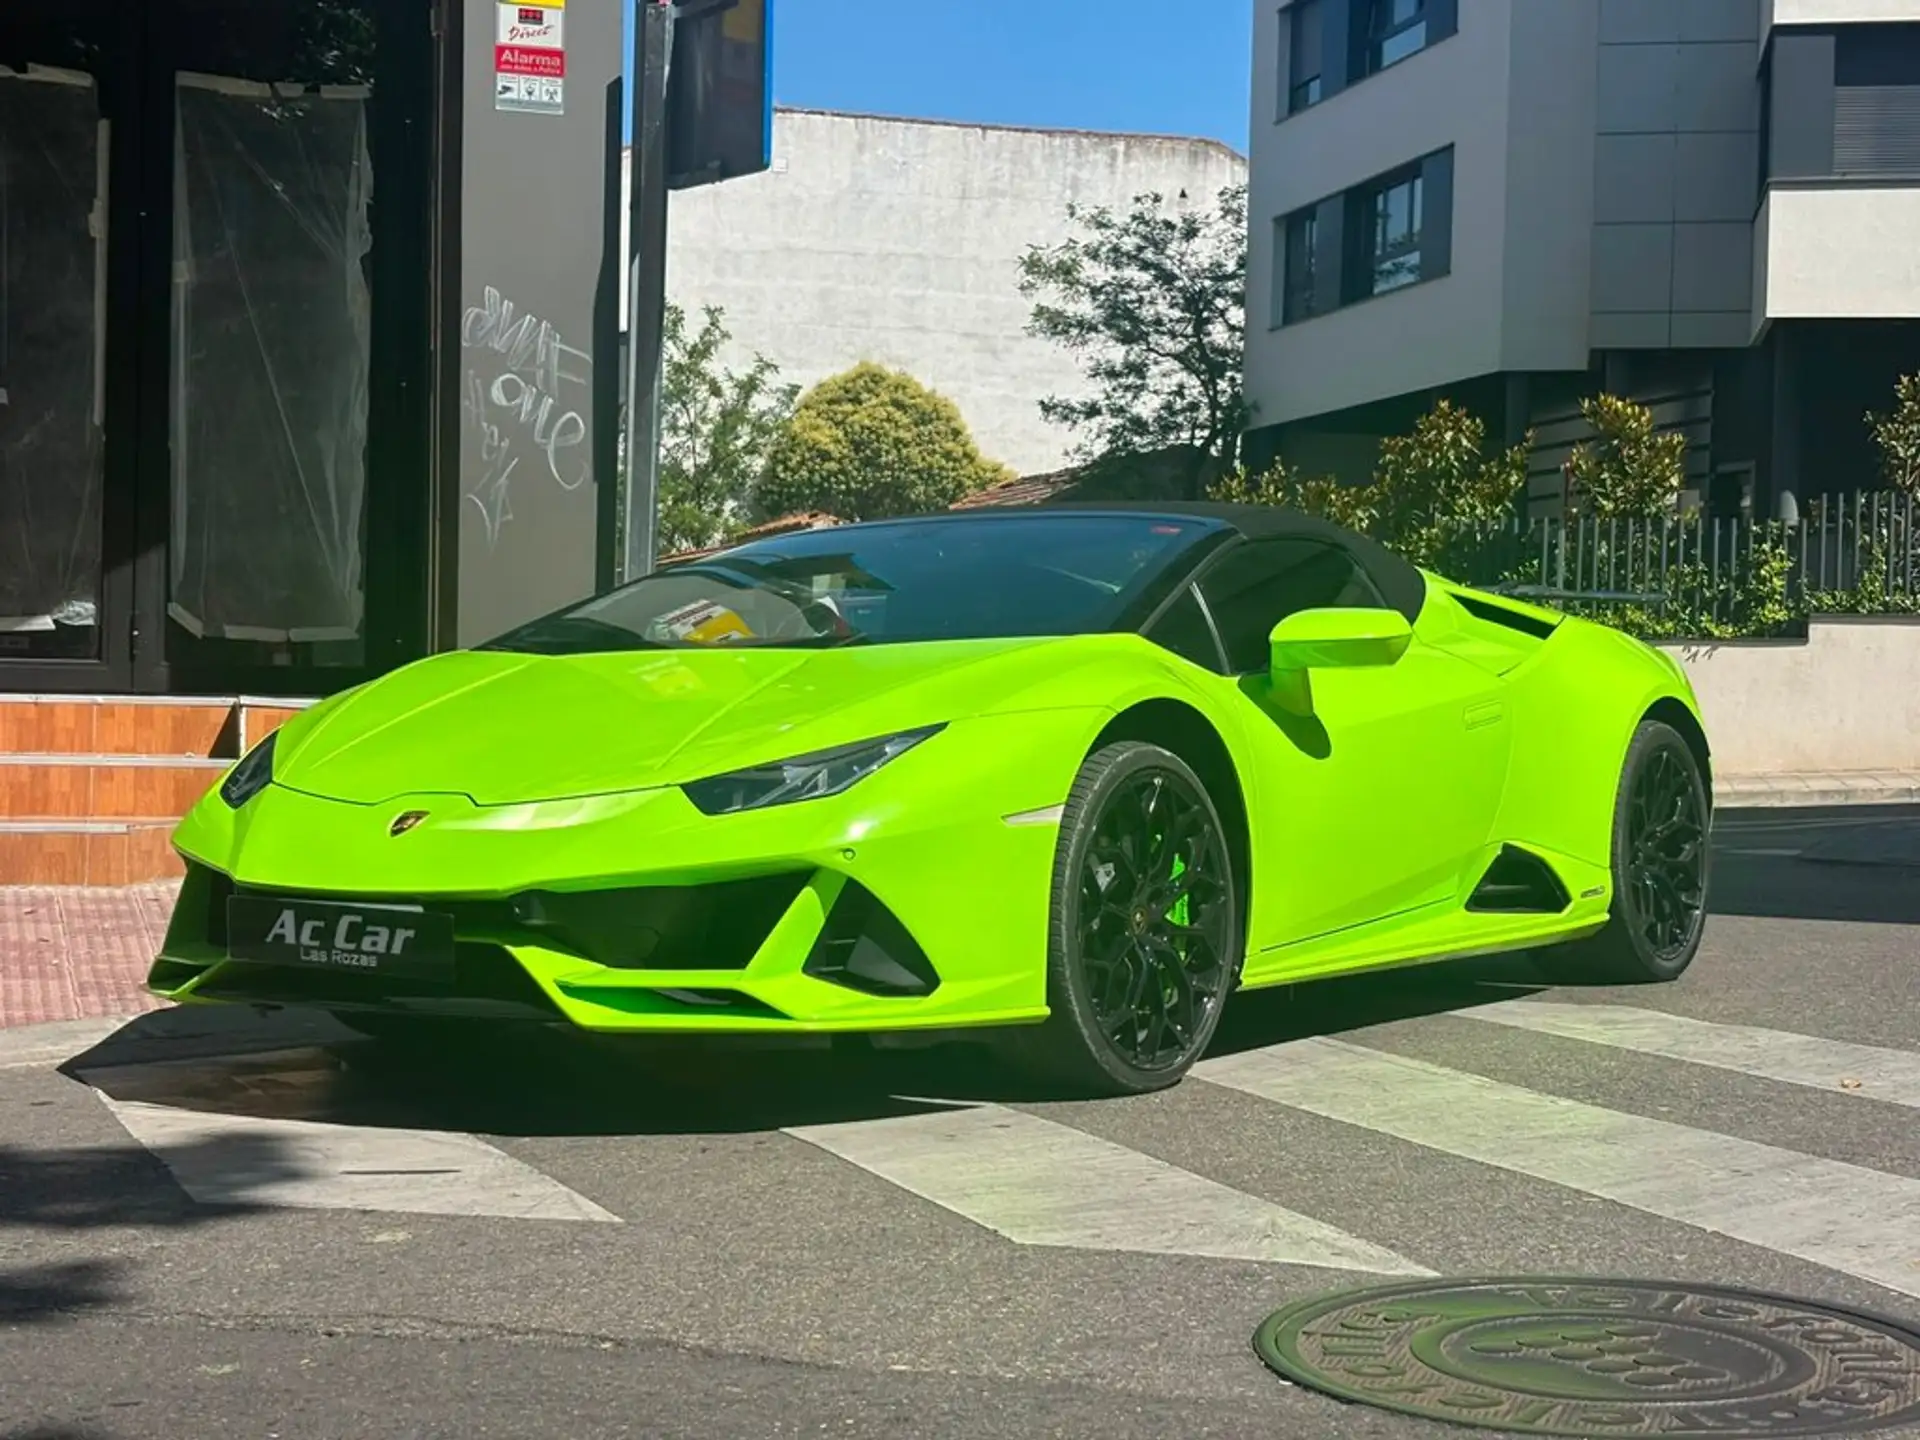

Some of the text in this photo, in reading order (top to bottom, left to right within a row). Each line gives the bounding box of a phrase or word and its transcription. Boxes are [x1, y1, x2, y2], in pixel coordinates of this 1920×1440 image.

[508, 24, 554, 41] Direct
[501, 49, 561, 66] Alarma
[265, 909, 415, 955] Ac Car
[300, 946, 377, 967] Las Rozas
